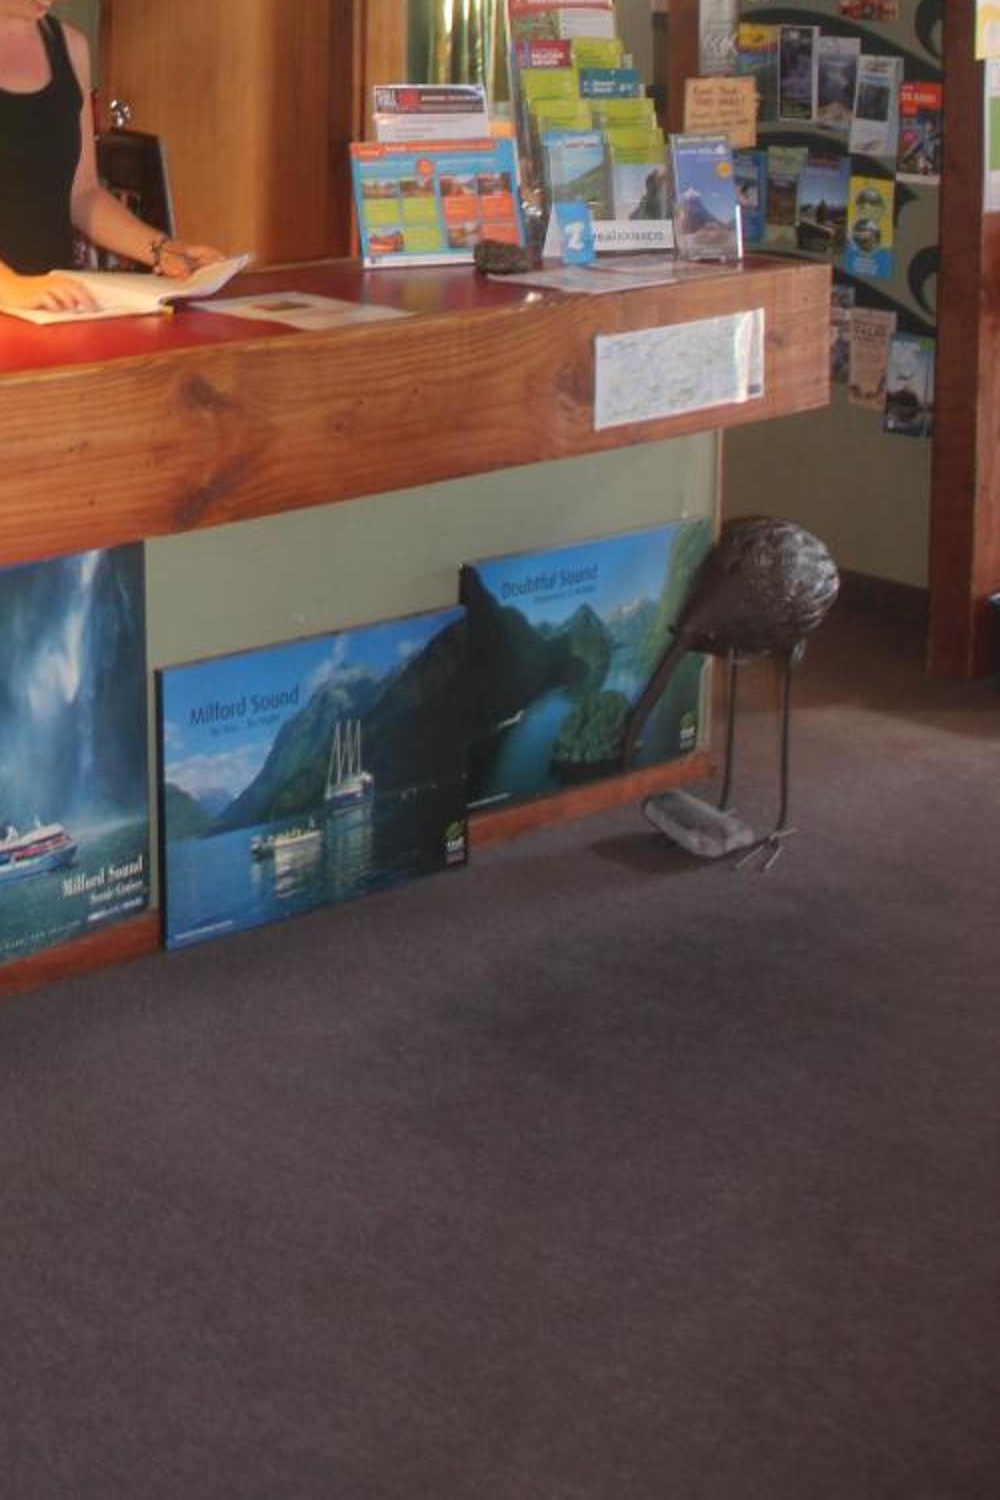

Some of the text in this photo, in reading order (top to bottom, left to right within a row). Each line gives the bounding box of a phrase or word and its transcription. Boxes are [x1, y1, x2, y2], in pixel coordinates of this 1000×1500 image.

[559, 564, 599, 587] Sound
[190, 695, 248, 725] Milford
[250, 683, 301, 713] Sound
[62, 853, 143, 898] Milford Sound
